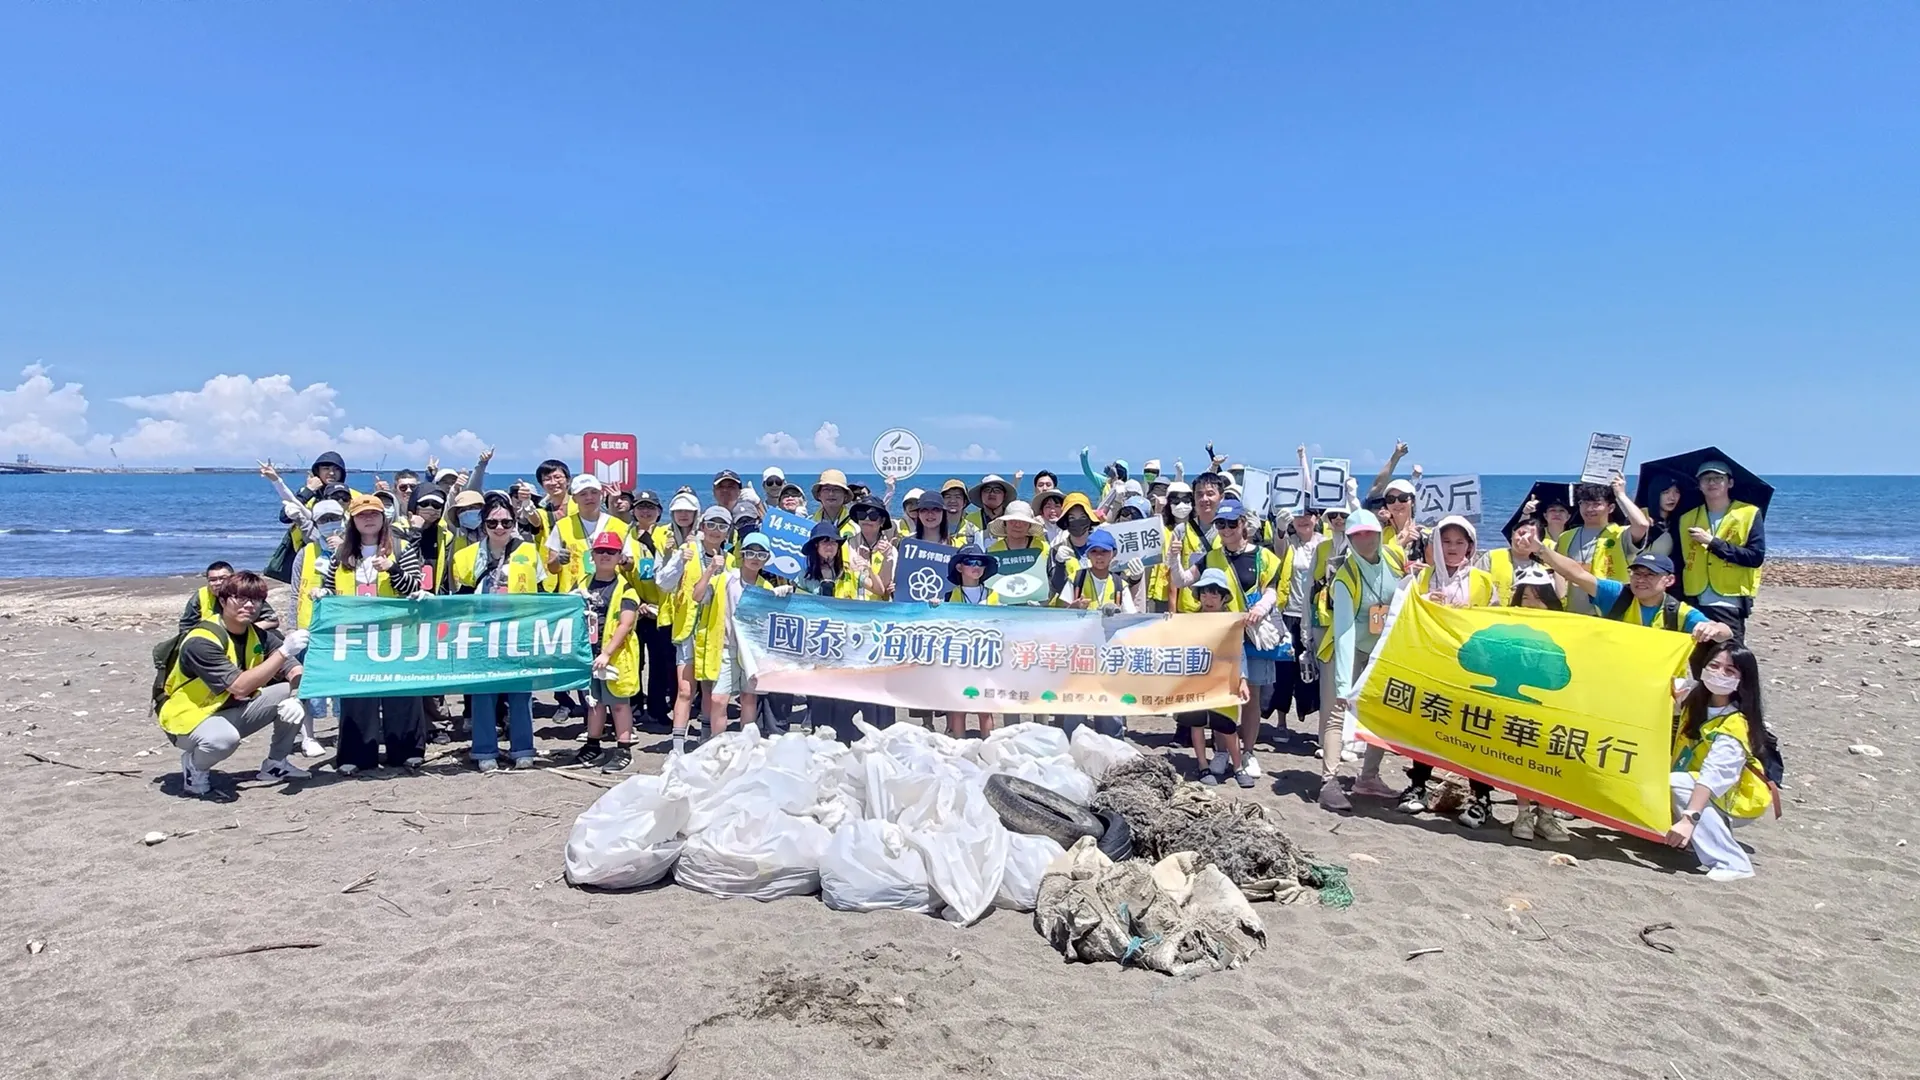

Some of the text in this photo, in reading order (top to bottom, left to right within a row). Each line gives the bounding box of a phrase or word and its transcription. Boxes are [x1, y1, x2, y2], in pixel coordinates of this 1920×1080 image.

[591, 438, 599, 451] 4
[1274, 472, 1302, 508] 5
[1315, 466, 1344, 502] 8
[1420, 480, 1477, 512] 公斤
[769, 514, 811, 537] 14 水下生
[1118, 528, 1161, 553] 清除
[904, 544, 918, 559] 17
[333, 618, 574, 661] FUJIFILM
[350, 674, 393, 682] FUJIFILM
[394, 673, 434, 682] Business
[1382, 676, 1638, 774] 國泰世華銀行
[1435, 731, 1562, 778] Cathay United Bank
